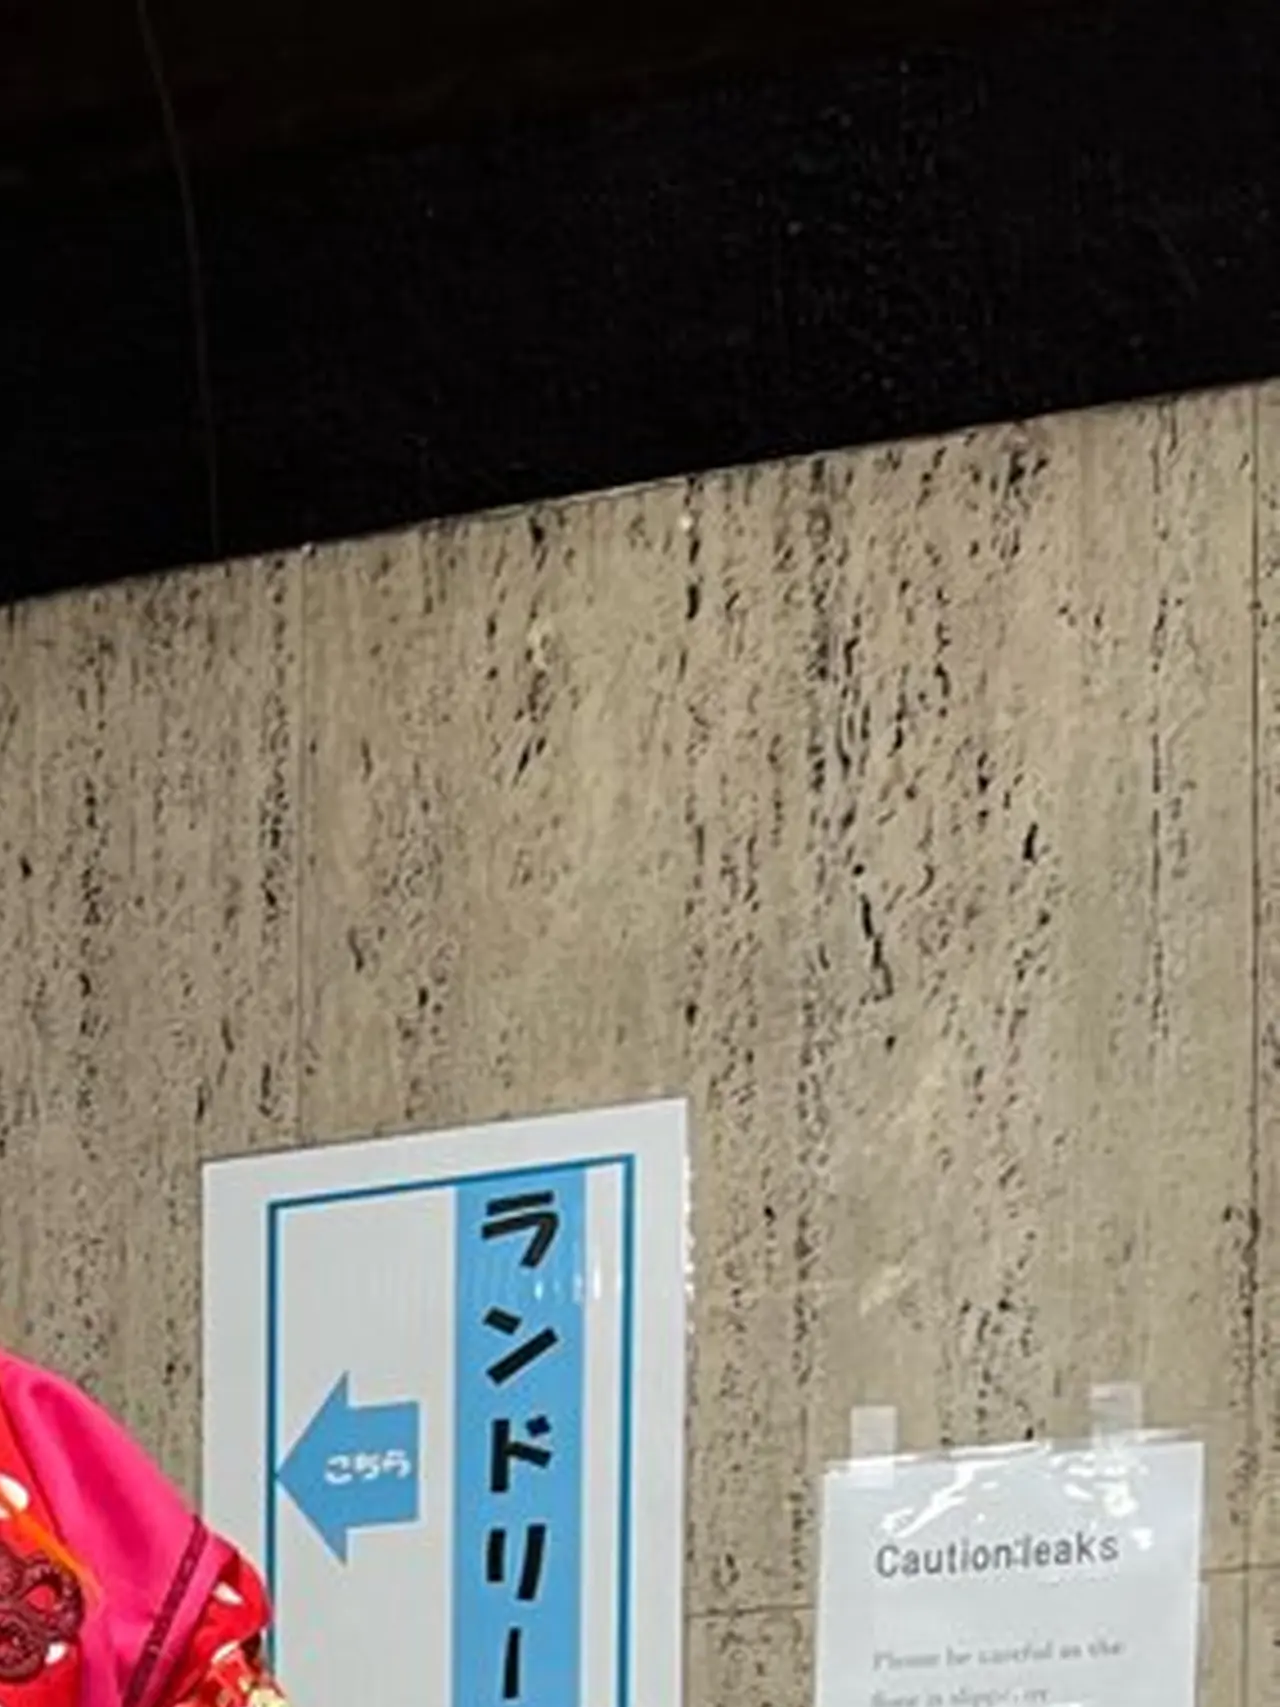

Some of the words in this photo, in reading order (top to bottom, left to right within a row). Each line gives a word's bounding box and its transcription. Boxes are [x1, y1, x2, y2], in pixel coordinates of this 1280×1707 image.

[324, 1449, 411, 1486] こちら
[481, 1190, 560, 1701] ランドリー
